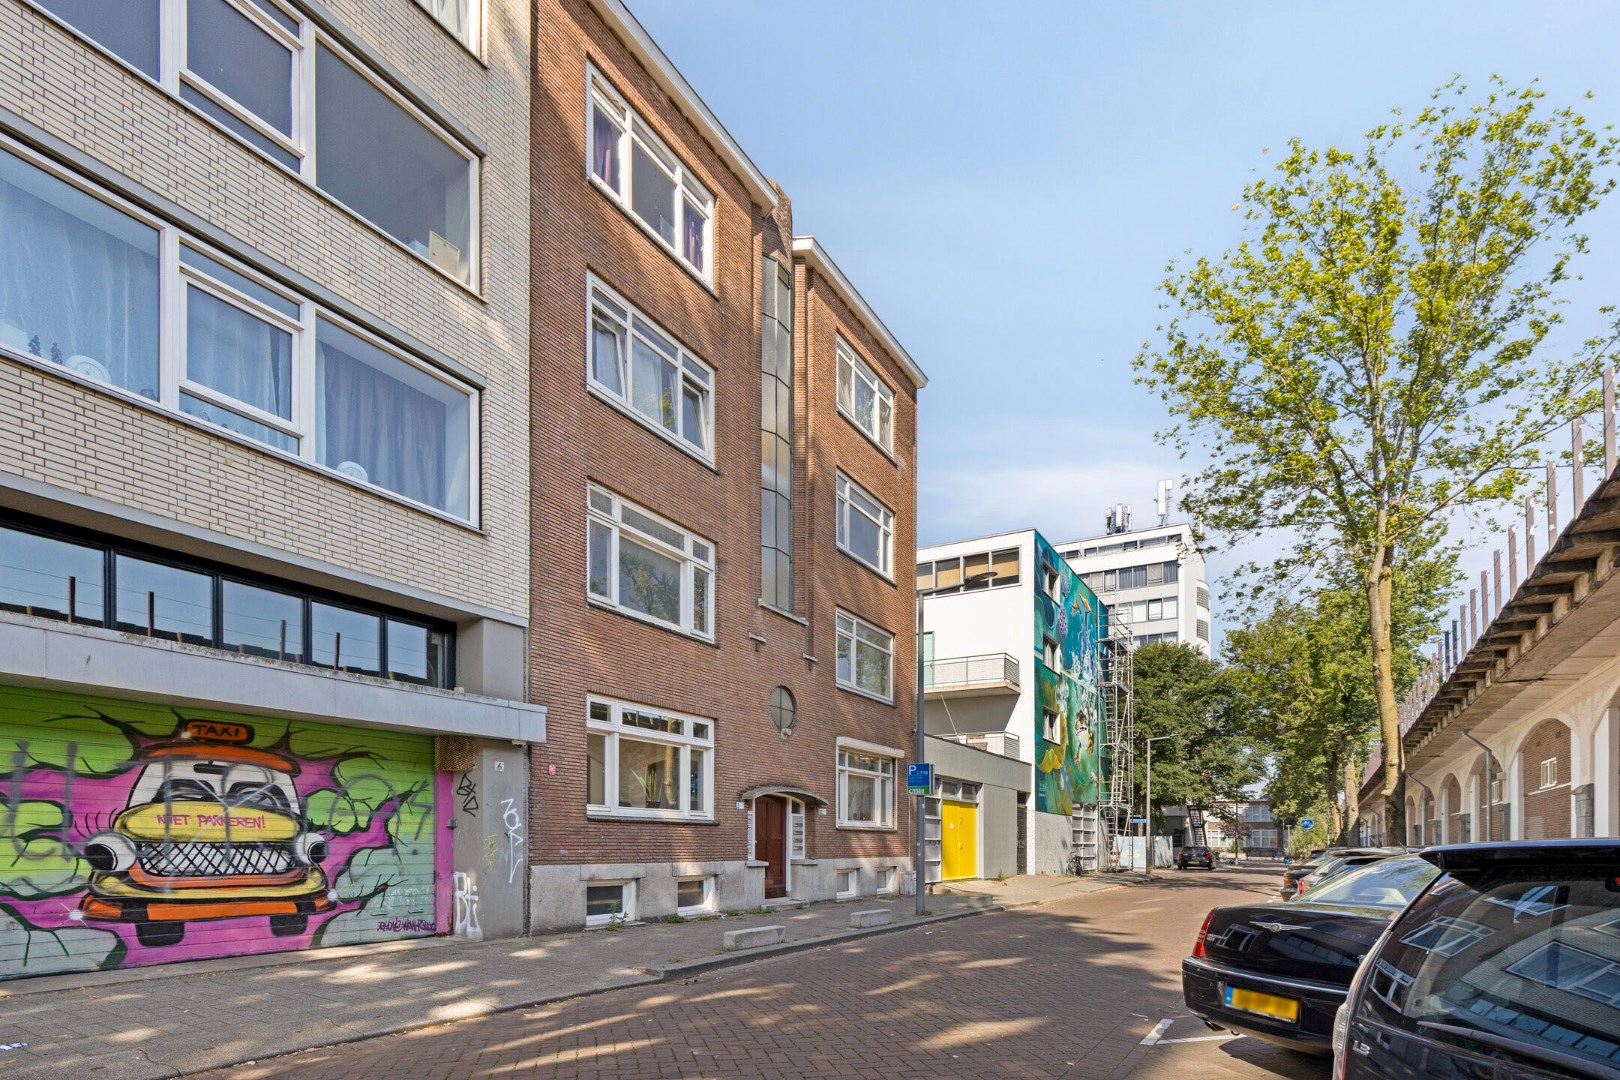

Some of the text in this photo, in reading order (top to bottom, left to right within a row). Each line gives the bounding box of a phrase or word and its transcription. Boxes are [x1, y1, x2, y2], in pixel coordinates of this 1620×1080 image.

[192, 724, 239, 737] TAXI
[909, 765, 917, 775] P
[156, 814, 266, 829] NIET PARKEREN!
